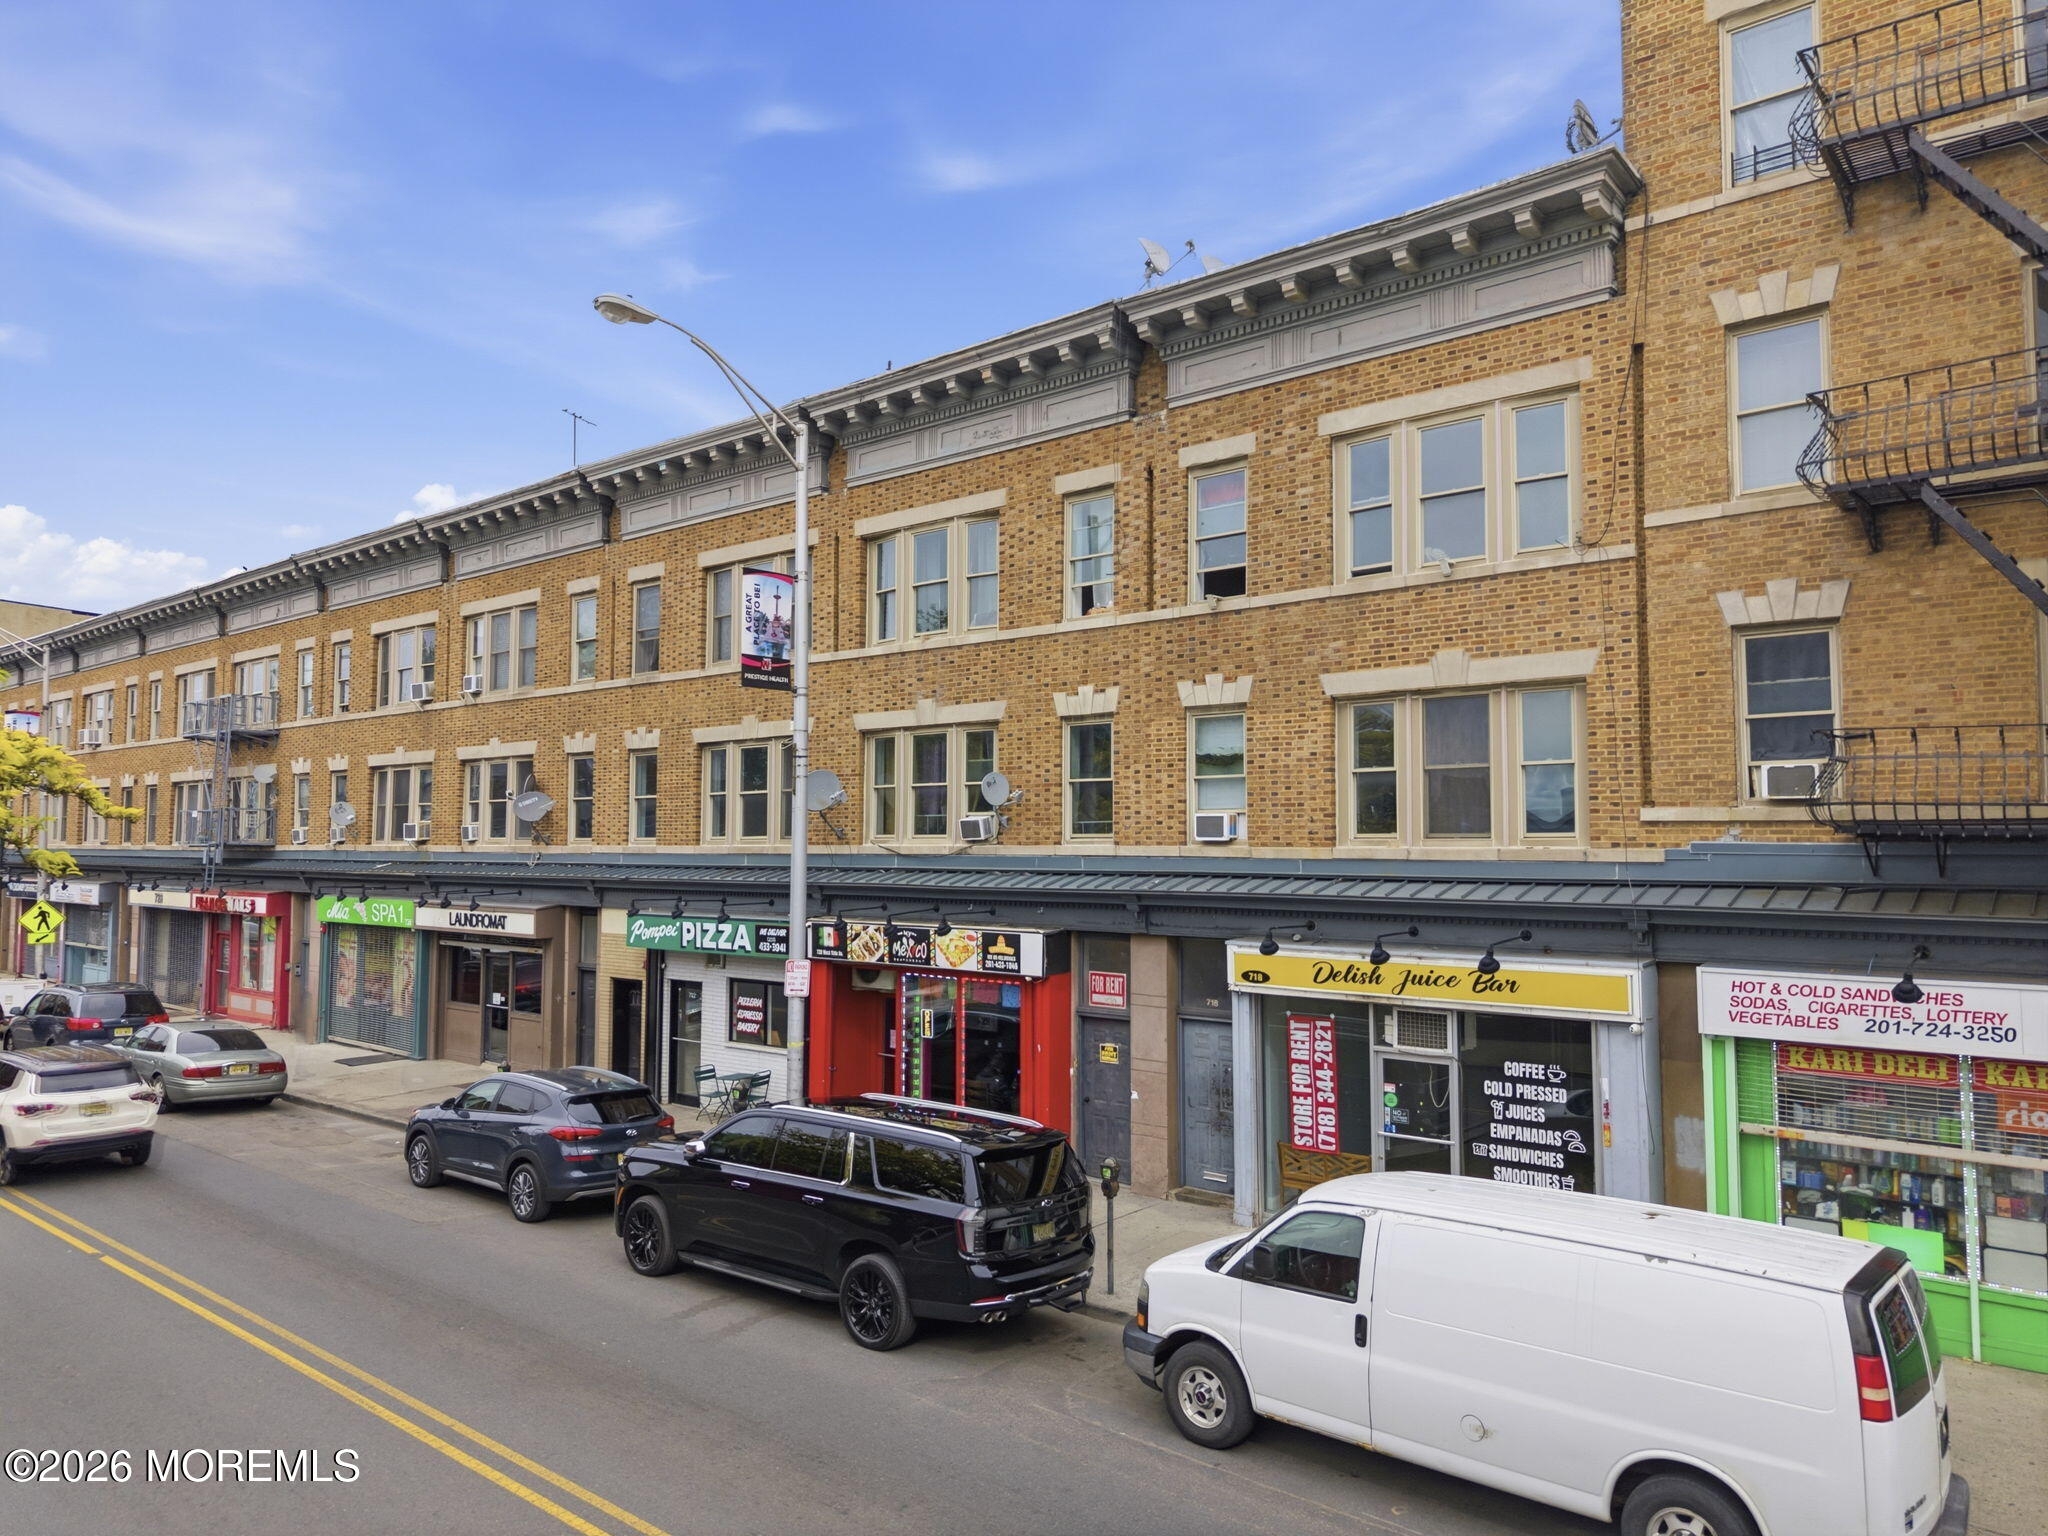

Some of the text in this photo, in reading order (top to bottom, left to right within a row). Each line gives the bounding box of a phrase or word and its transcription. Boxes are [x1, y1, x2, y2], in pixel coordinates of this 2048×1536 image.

[753, 603, 761, 615] TO
[753, 617, 761, 645] PLACE
[744, 672, 788, 683] PRESTIGE HEALTH
[449, 912, 508, 930] LAUNDROMAT
[629, 919, 752, 952] Pompei PIZZA
[1091, 974, 1124, 995] FOR RENT
[1248, 960, 1520, 996] 718 Delish Juice Bar
[737, 996, 763, 1008] PIZZERIA
[1206, 998, 1219, 1007] 718
[1731, 980, 1964, 1007] HOT & COLD SANDHES
[737, 1009, 763, 1021] ESPRESSO
[1729, 995, 2009, 1026] SODAS, CIGARETTES, LOTTERY
[737, 1022, 760, 1034] BAKERY
[1728, 1010, 2017, 1044] VEGETABLES 201-724-3250
[1503, 1061, 1546, 1080] COFFEE
[1787, 1045, 1950, 1081] KARI DELI
[1289, 1019, 1314, 1147] STORE FOR RENT
[1313, 1020, 1336, 1151] (718) 344-2821
[1483, 1080, 1567, 1103] COLD PRESSED
[1505, 1101, 1546, 1122] JUICES
[1490, 1123, 1563, 1147] EMPANADAS
[1488, 1144, 1565, 1169] SANDWICHES
[1493, 1165, 1561, 1190] SMOOTHIES
